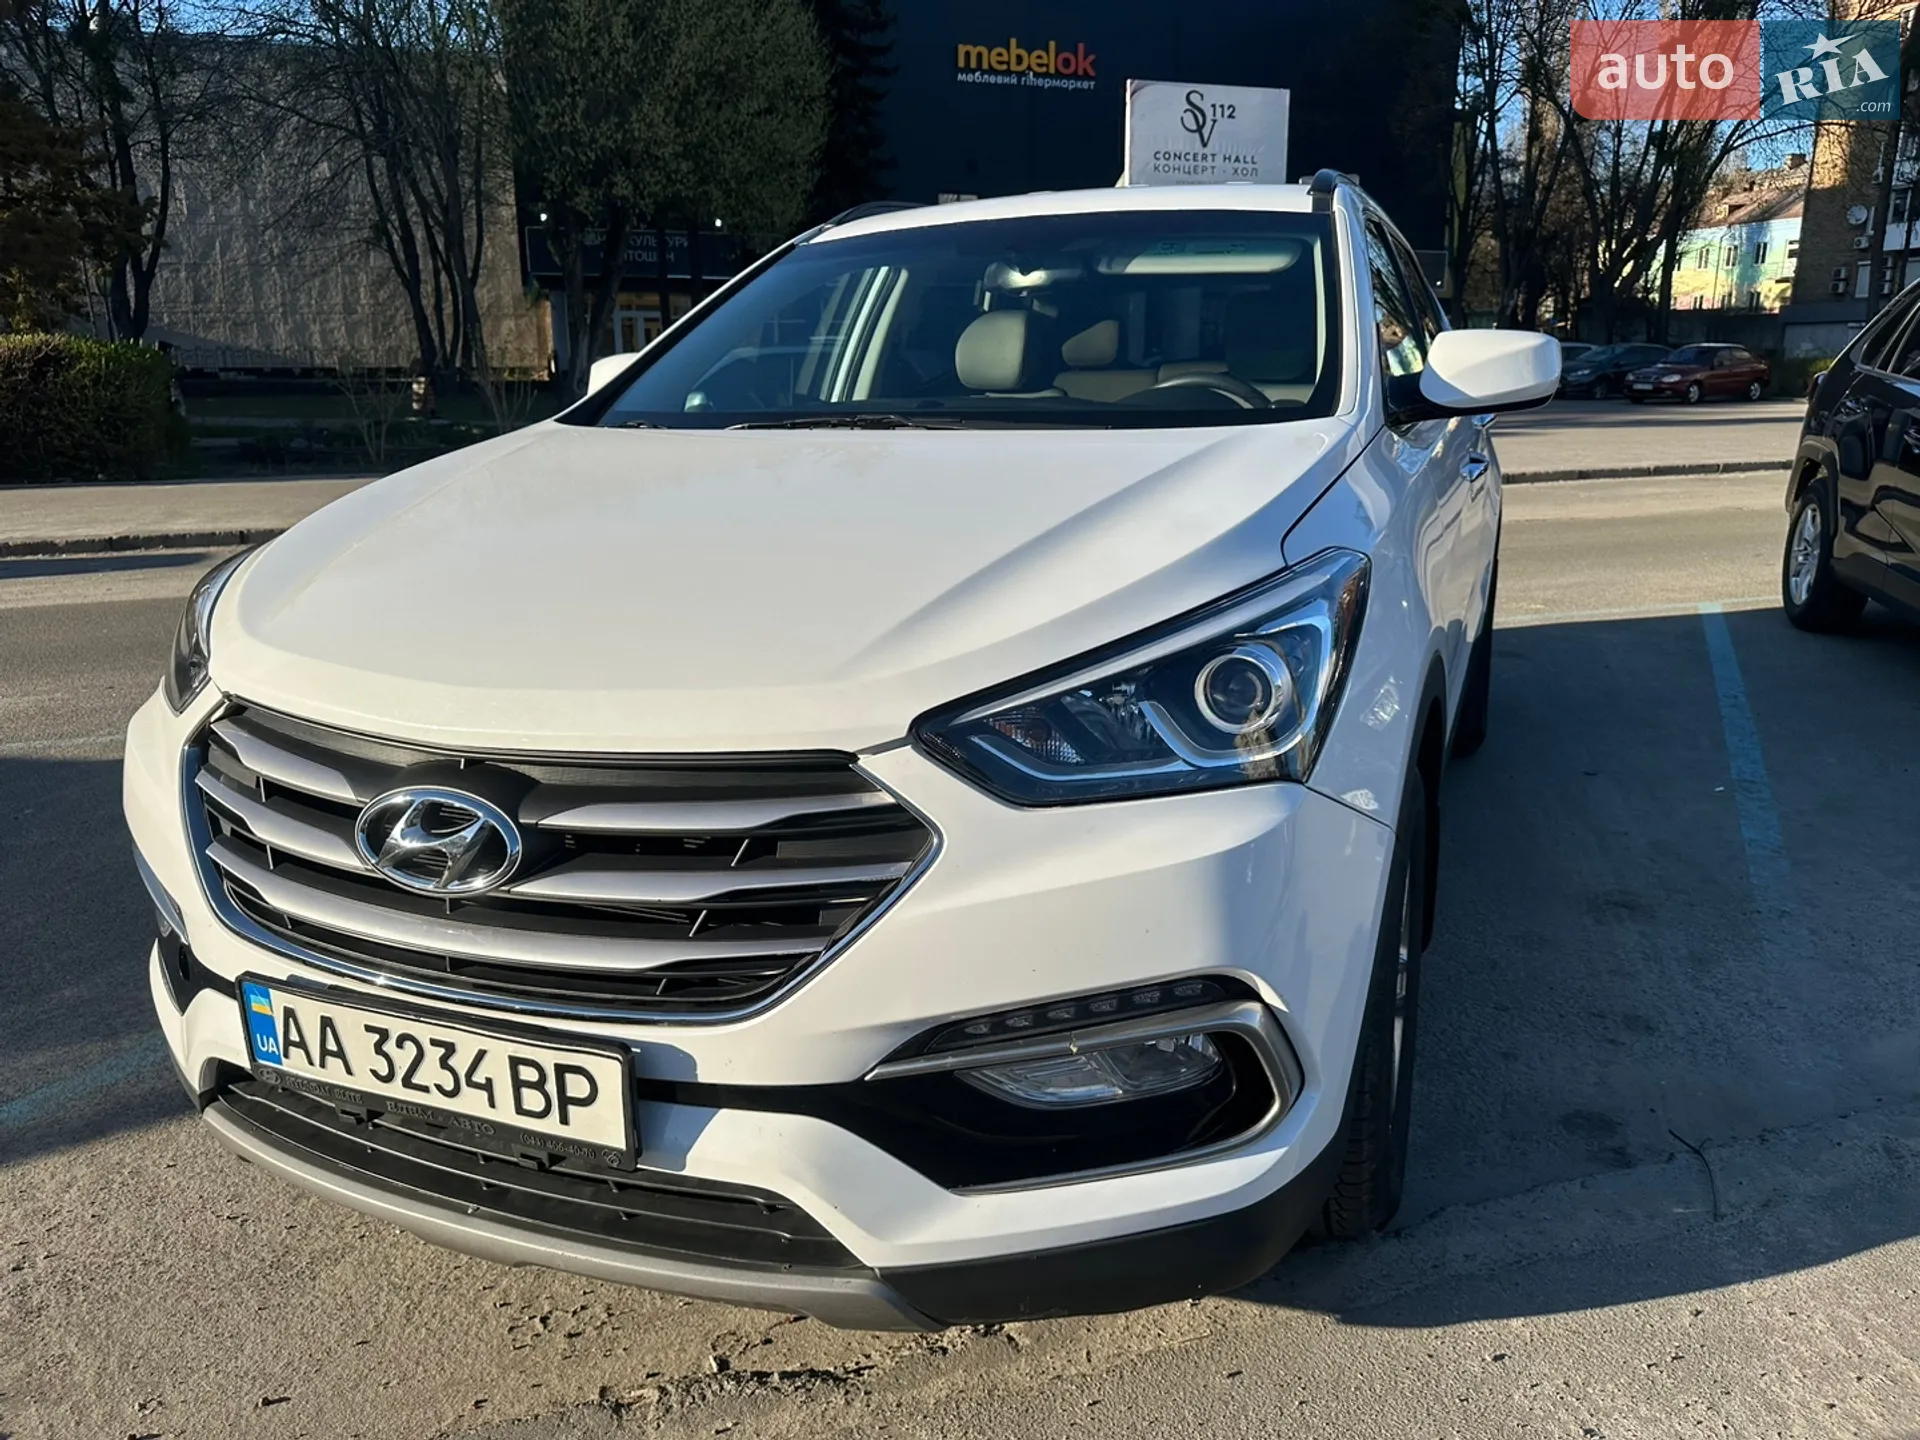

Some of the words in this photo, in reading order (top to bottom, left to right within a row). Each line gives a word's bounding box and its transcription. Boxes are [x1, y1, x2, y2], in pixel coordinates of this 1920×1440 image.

[957, 37, 1097, 77] mebelok
[1210, 103, 1236, 119] 112
[1153, 151, 1218, 163] CONCERT
[1223, 153, 1258, 165] HALL
[1153, 163, 1217, 176] КОНЦЕРТ
[1231, 166, 1258, 177] ХОЛ
[256, 1032, 280, 1056] UA
[281, 1006, 354, 1076] AA
[364, 1023, 497, 1109] 3234
[507, 1055, 599, 1126] BP
